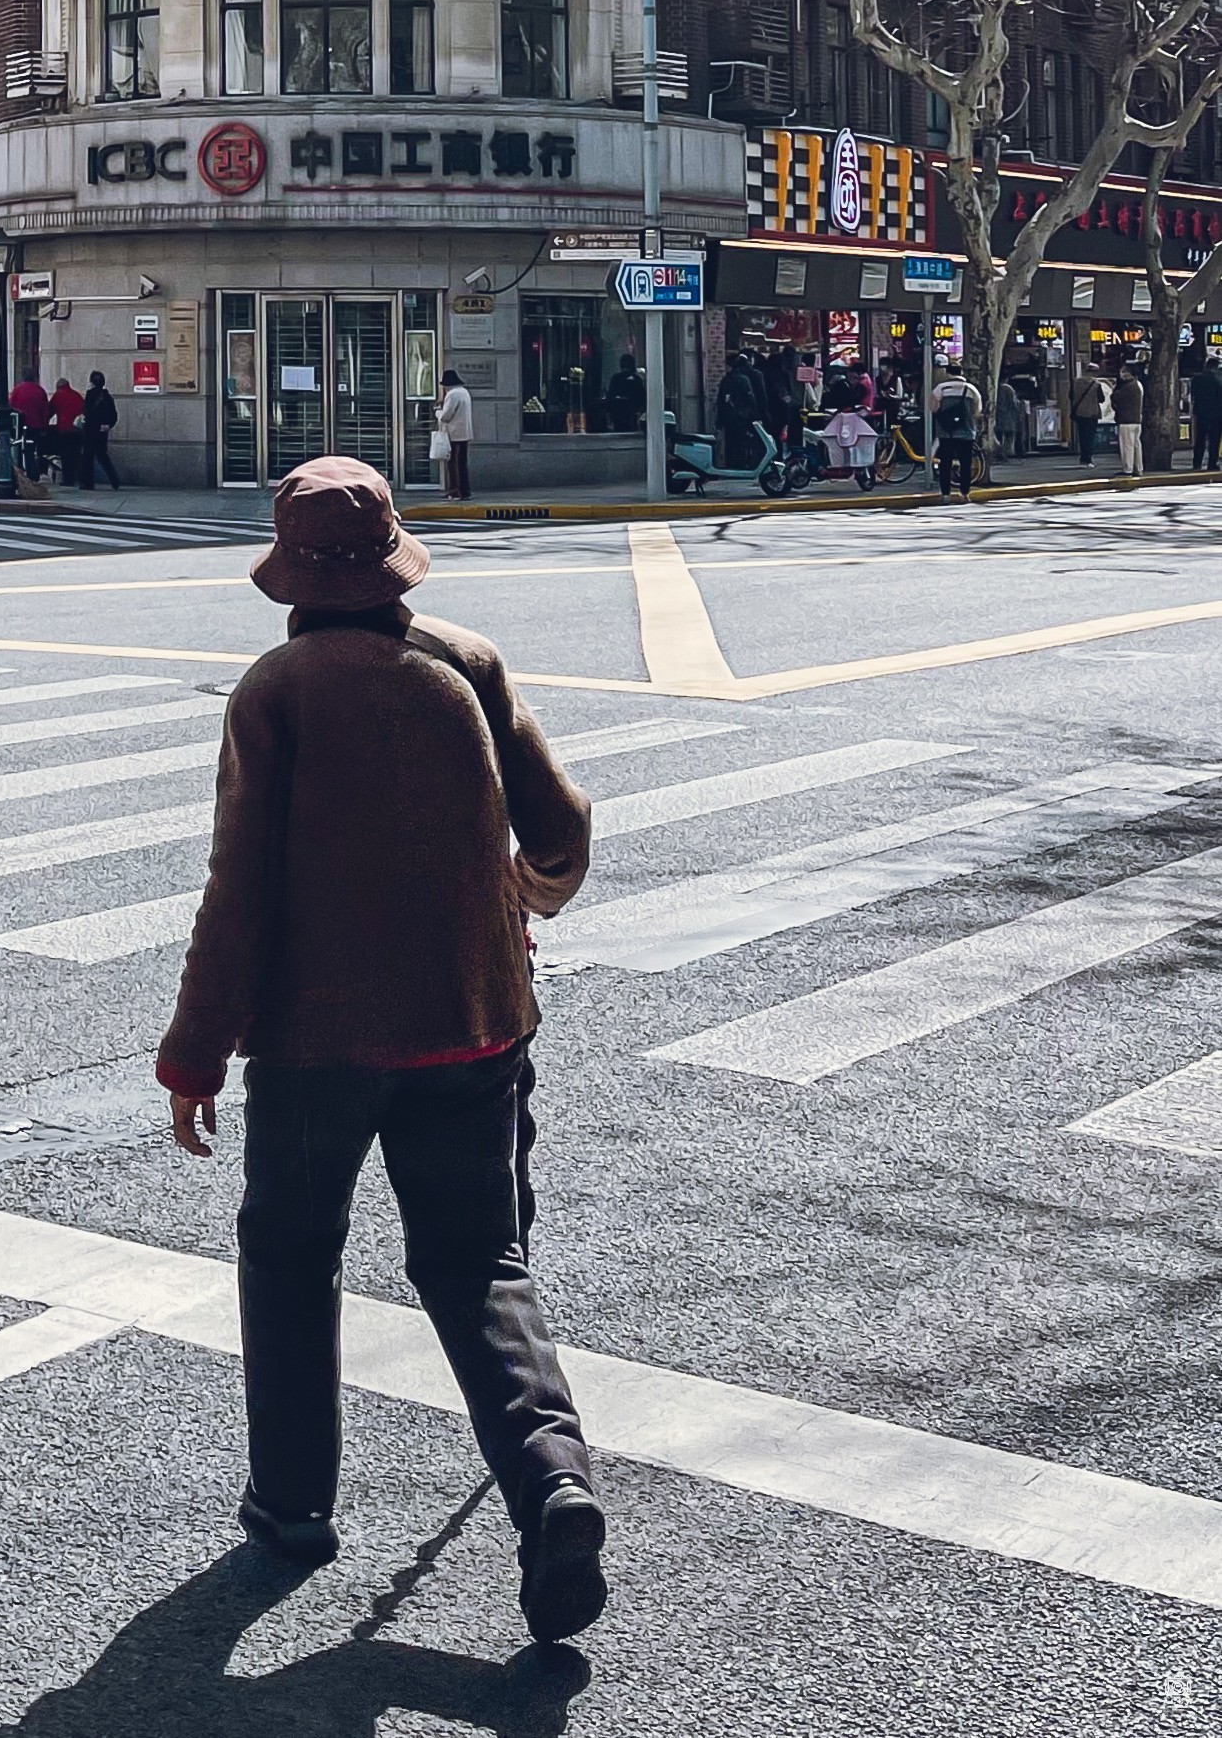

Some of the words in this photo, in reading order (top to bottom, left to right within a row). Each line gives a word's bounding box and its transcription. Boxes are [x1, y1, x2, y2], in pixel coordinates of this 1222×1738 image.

[88, 140, 187, 185] ICBC
[290, 129, 576, 184] 中国工商银行
[675, 268, 687, 286] 14
